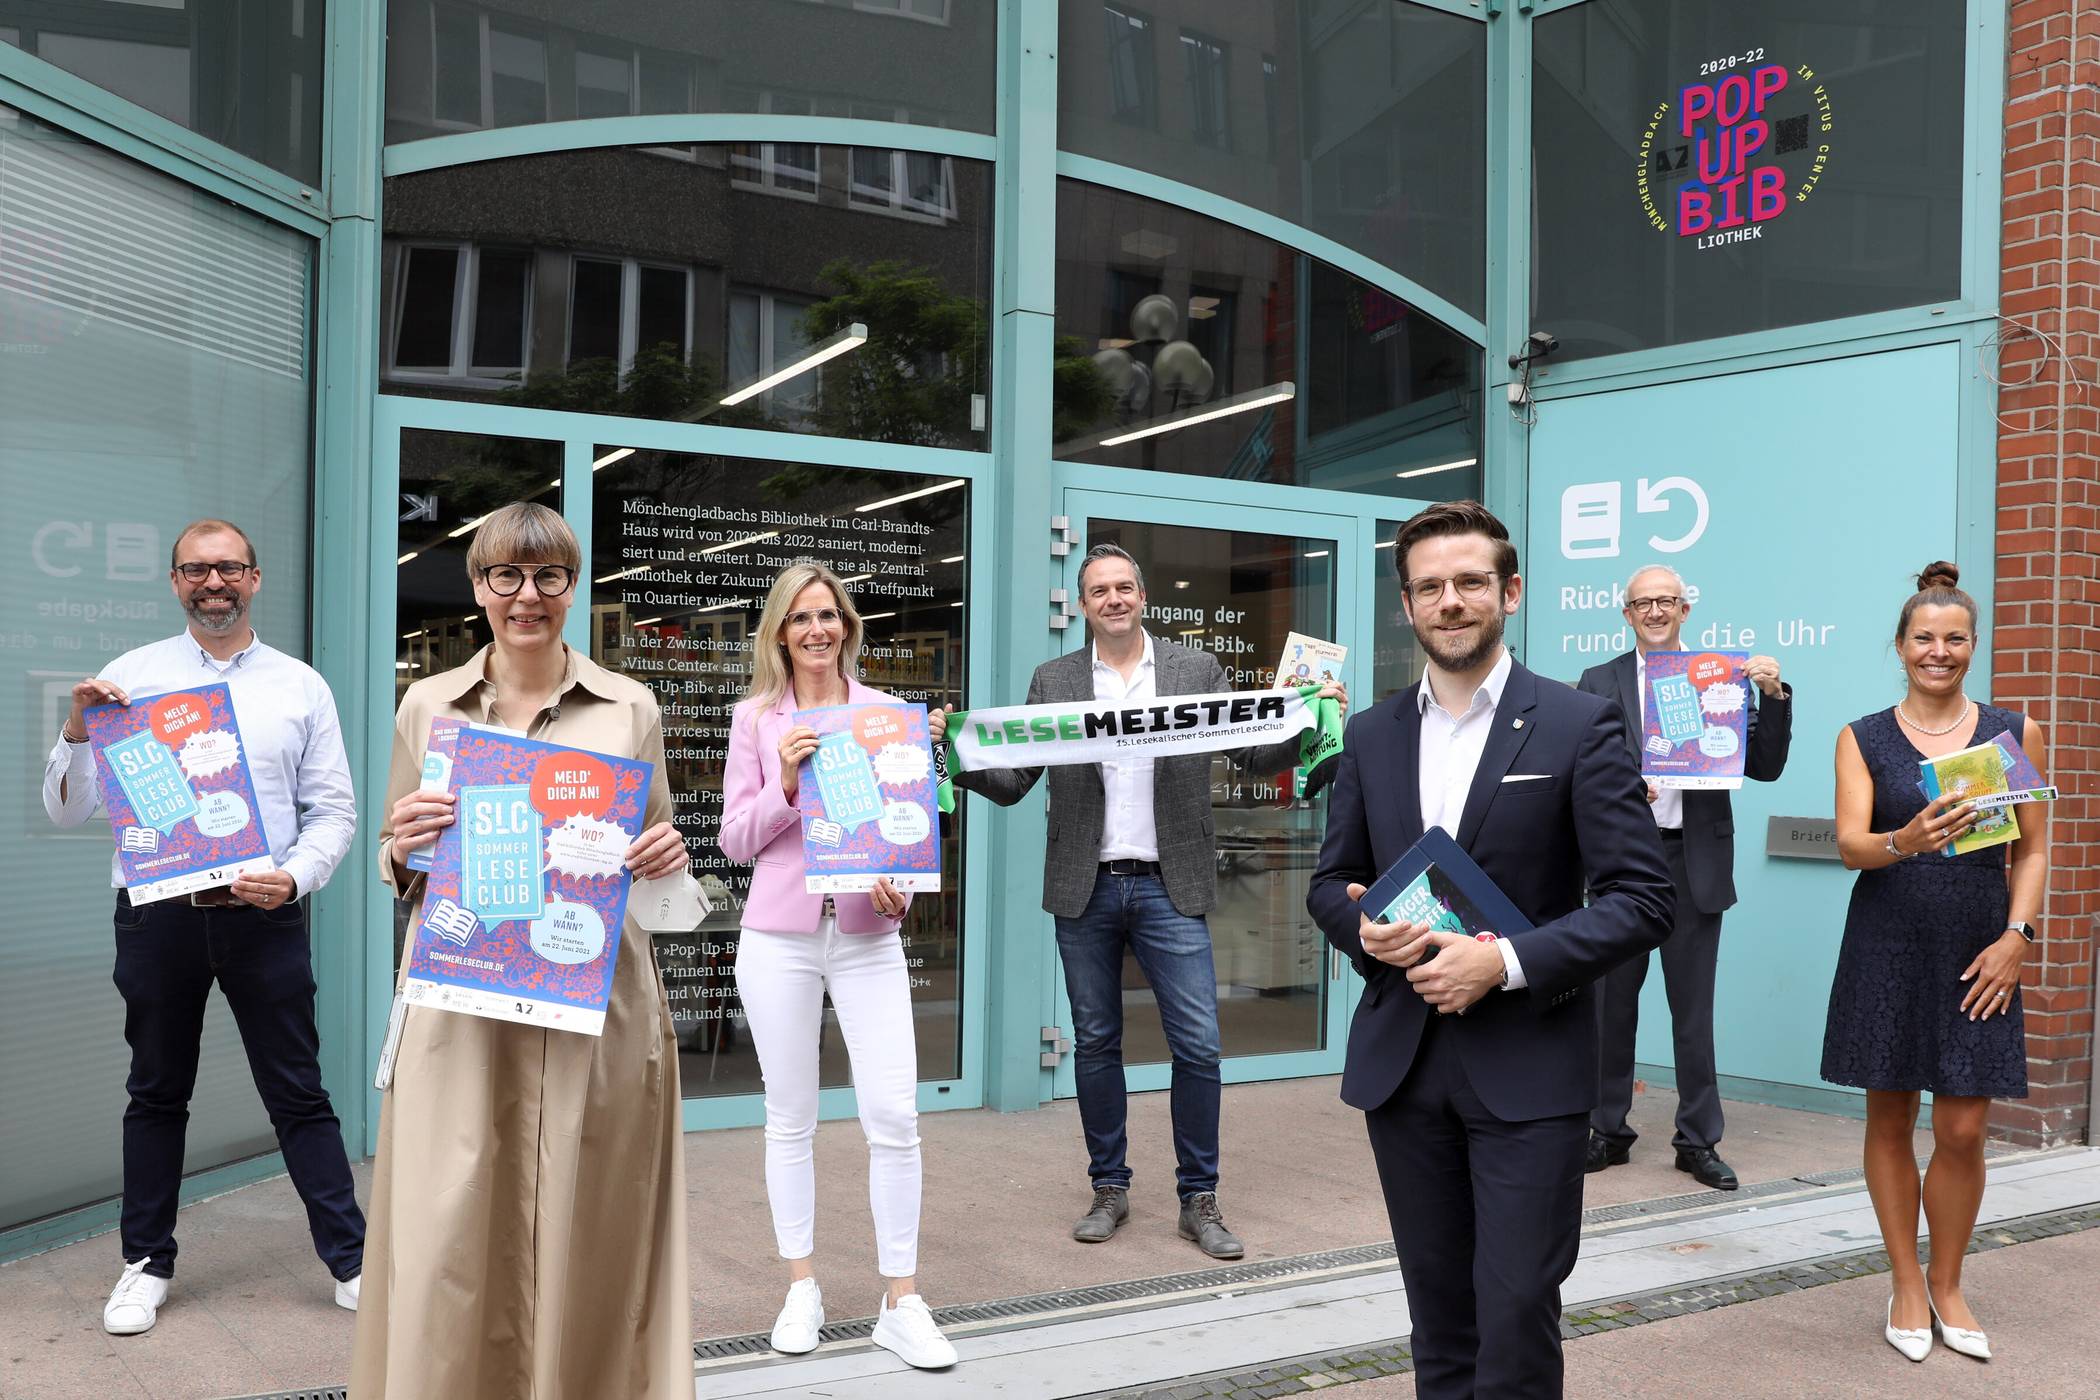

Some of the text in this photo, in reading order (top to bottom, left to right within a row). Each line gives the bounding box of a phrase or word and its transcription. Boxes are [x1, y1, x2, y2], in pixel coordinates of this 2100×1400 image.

[1700, 48, 1764, 76] 2020-22
[1679, 63, 1789, 138] POP
[1795, 64, 1832, 203] IM VITUS CENTER
[1696, 119, 1769, 185] UP
[1637, 102, 1669, 232] MÖNCHENGLADBACH
[1677, 165, 1787, 236] BIB
[1698, 225, 1762, 250] LIOTHEK
[623, 500, 935, 535] Mönchengladbachs Bibliothek im Carl-Brandts-
[622, 523, 926, 555] Haus wird von 2020 bis 2022 saniert, moderni-
[622, 546, 654, 559] siert
[658, 547, 685, 561] und
[688, 550, 753, 566] erweitert.
[756, 553, 792, 568] Dann
[838, 558, 856, 573] sie
[859, 559, 877, 573] als
[880, 561, 929, 576] Zentral-
[622, 567, 693, 584] bibliothek
[695, 571, 718, 585] der
[846, 581, 865, 593] als
[868, 581, 935, 598] Treffpunkt
[622, 589, 641, 603] im
[644, 590, 702, 606] Quartier
[706, 594, 751, 609] wieder
[1141, 603, 1245, 624] ingang der
[1562, 619, 1836, 653] rund die Uhr
[621, 635, 636, 648] In
[639, 635, 663, 649] der
[666, 636, 754, 651] Zwischenzei
[872, 646, 892, 660] qm
[896, 645, 913, 658] im
[621, 657, 664, 671] »Vitus
[667, 658, 719, 673] Center«
[722, 662, 744, 673] am
[1224, 666, 1275, 683] Cente
[1660, 682, 1691, 702] SLC
[659, 703, 721, 718] efragten
[1667, 711, 1695, 724] LESE
[163, 719, 186, 735] DICH
[662, 724, 709, 738] ervices
[975, 697, 1285, 747] LESEMEISTER
[1199, 722, 1285, 738] SommerLeseClub
[1669, 721, 1697, 736] CLUB
[118, 740, 164, 776] SLC
[664, 746, 729, 760] ostenfrei
[819, 742, 859, 772] SLC
[132, 766, 171, 790] SOMMER
[138, 777, 179, 805] LESE
[547, 783, 600, 801] DICH AN!
[831, 780, 869, 800] LESE
[1253, 782, 1282, 800] Uhr
[147, 794, 187, 821] CLUB
[475, 799, 529, 836] SLC
[836, 799, 874, 818] CLUB
[581, 828, 604, 842] WO?
[476, 842, 529, 856] SOMMER
[477, 858, 529, 880] LESE
[477, 882, 530, 906] CLUB
[553, 919, 584, 932] WANN?
[564, 910, 576, 920] AB
[663, 940, 740, 958] »Pop-Up-Bi
[429, 949, 505, 973] SOMMERLESECLUB.DE
[692, 986, 740, 999] Verans
[695, 1006, 722, 1020] und
